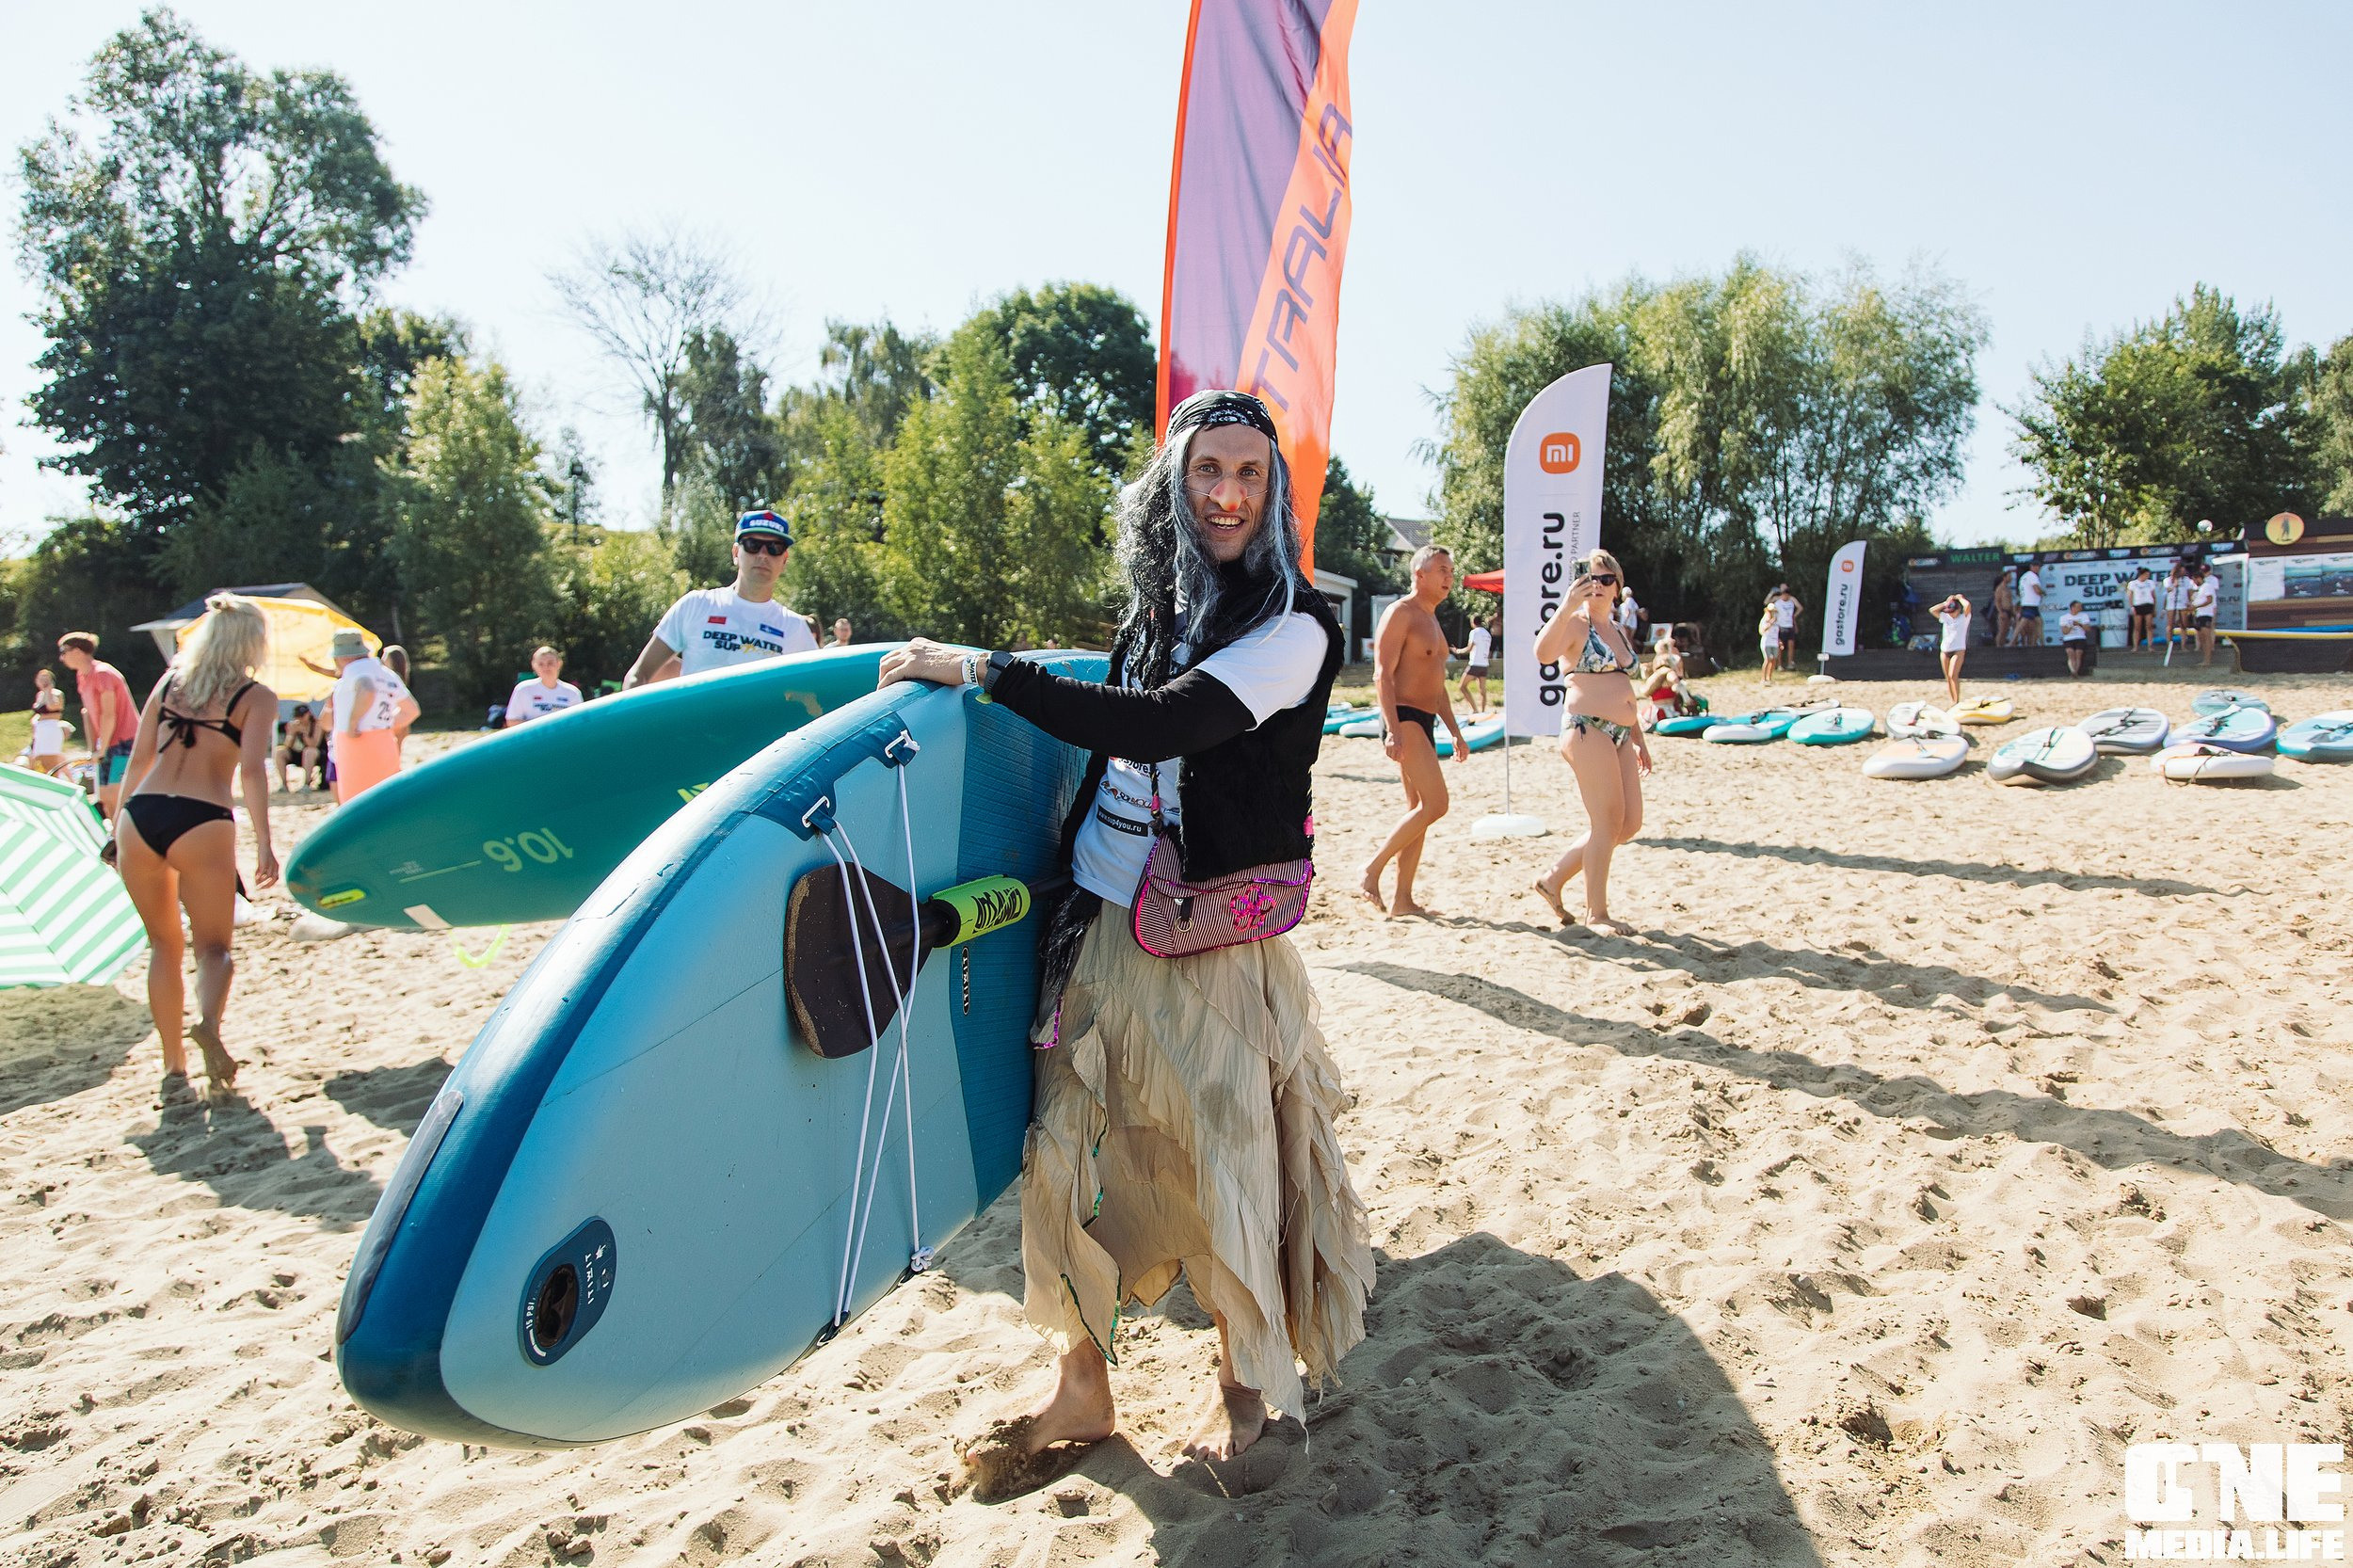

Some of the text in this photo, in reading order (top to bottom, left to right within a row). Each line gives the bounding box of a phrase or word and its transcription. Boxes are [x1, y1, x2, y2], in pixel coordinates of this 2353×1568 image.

[749, 519, 784, 533] SUZUKI
[1570, 511, 1581, 555] PARTNER
[1949, 552, 2001, 563] WALTER
[2064, 572, 2110, 585] DEEP
[2083, 584, 2118, 598] SUP
[1535, 512, 1567, 707] gaore.ru
[1835, 584, 1849, 647] gastore.ru
[703, 631, 737, 642] DEEP
[740, 634, 783, 655] WATER
[713, 640, 741, 651] SUP
[525, 1320, 534, 1329] 15
